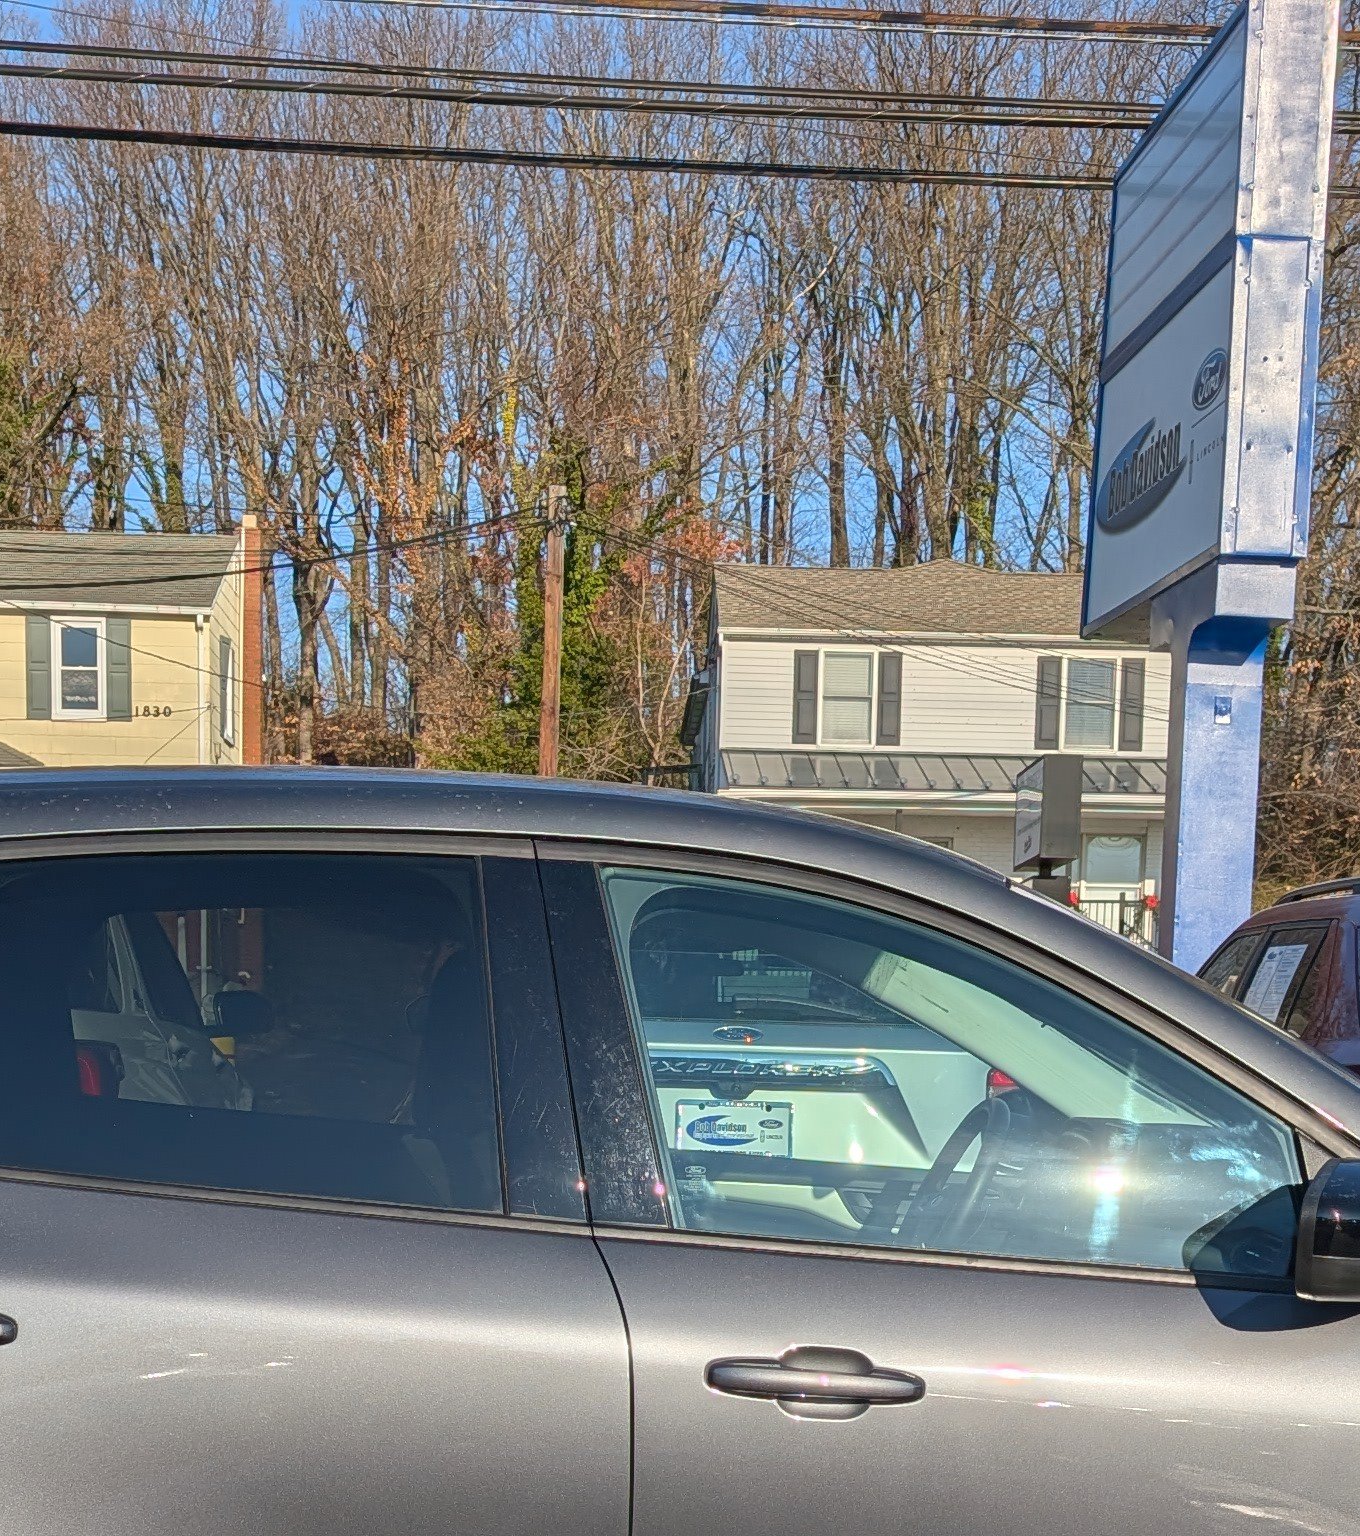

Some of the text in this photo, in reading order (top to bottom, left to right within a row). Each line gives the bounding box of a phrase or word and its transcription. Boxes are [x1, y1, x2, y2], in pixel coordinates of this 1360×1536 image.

[1197, 359, 1223, 404] Ford
[1107, 422, 1182, 521] Bob Davidson
[135, 705, 172, 717] 1830
[694, 1121, 747, 1133] Bob Davidson
